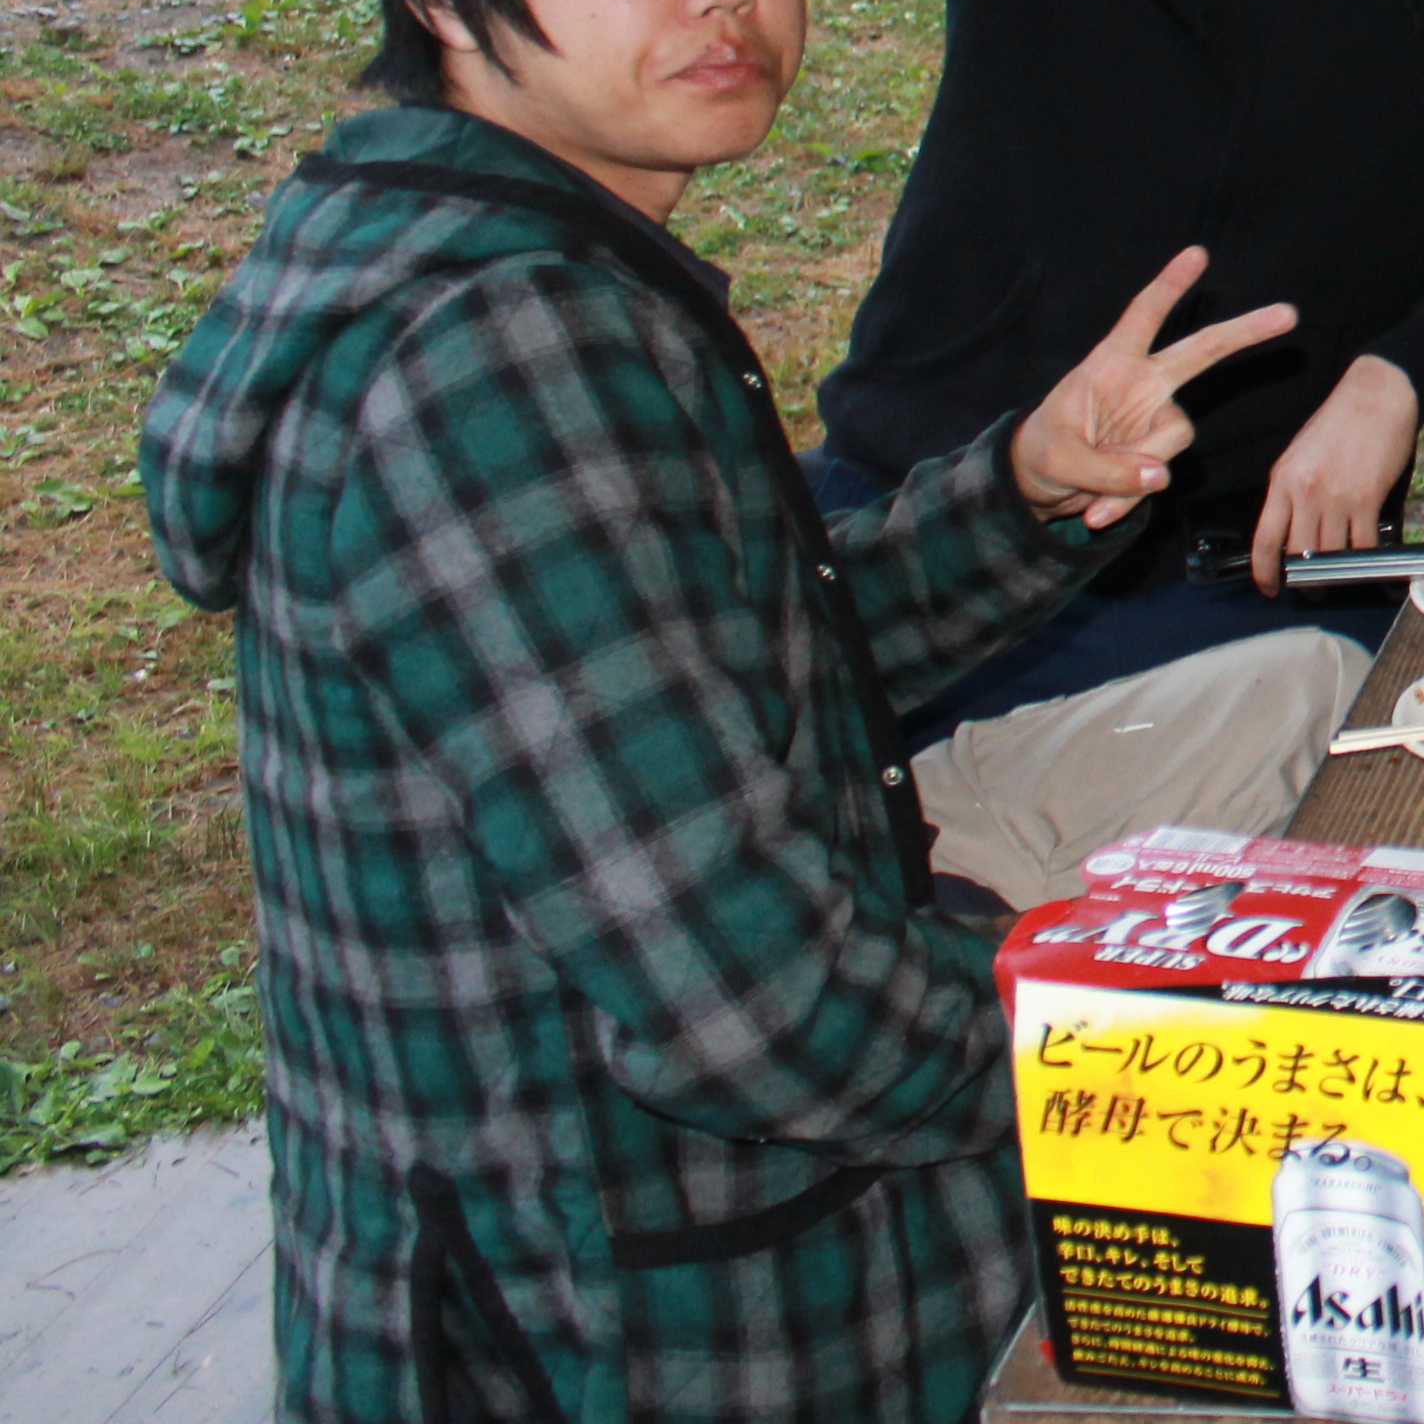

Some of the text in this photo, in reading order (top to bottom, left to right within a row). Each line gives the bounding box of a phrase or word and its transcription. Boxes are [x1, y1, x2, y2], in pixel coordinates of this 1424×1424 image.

[1093, 943, 1208, 971] SUPER
[1040, 1088, 1373, 1174] 酵母で決まる。
[1052, 1214, 1181, 1249] 味の決め手は、
[1056, 1238, 1206, 1275] 辛口、キレ、そして
[1060, 1264, 1271, 1310] できたてのうまさの追求。
[1342, 1357, 1385, 1384] 生
